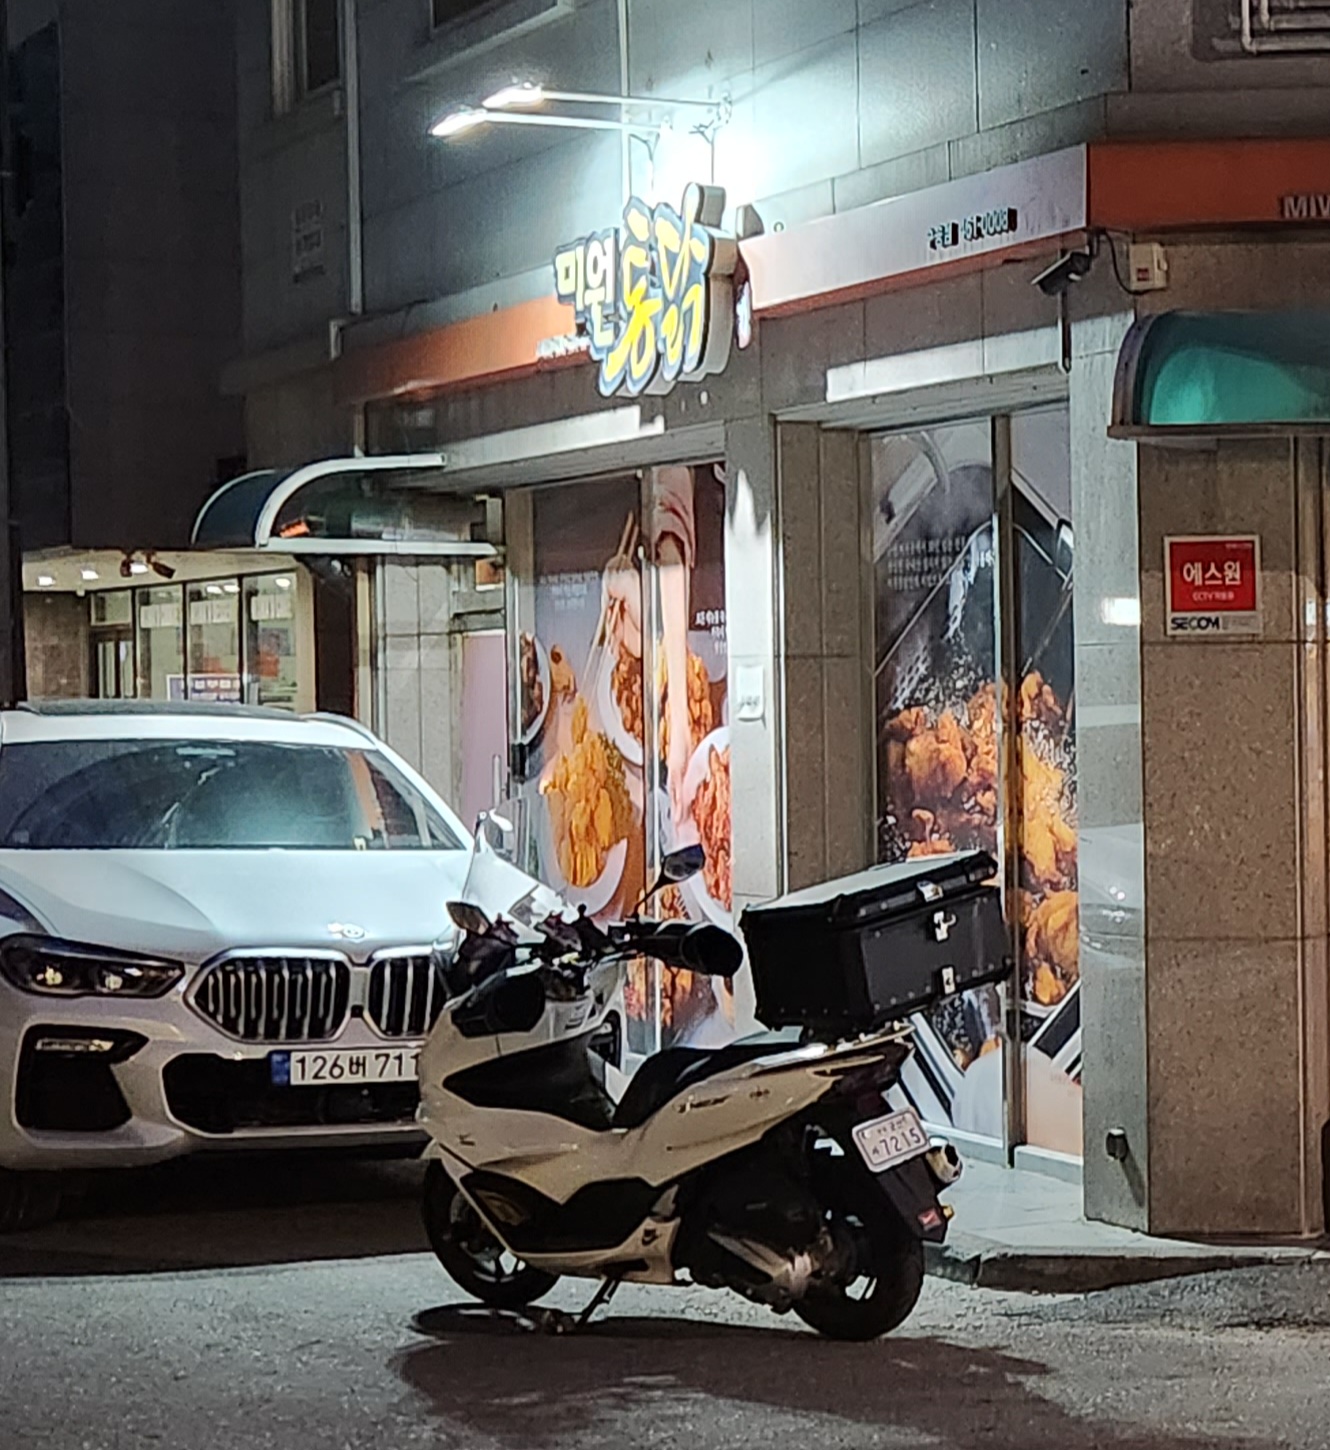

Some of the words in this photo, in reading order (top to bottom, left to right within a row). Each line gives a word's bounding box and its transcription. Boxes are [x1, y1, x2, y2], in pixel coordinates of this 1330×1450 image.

[555, 237, 617, 346] 미원
[606, 183, 704, 385] 통닭
[1183, 561, 1242, 586] 에스원
[1171, 616, 1220, 630] SECOM
[296, 1054, 366, 1080] 126버
[374, 1053, 419, 1077] 711
[880, 1127, 921, 1156] 7215
